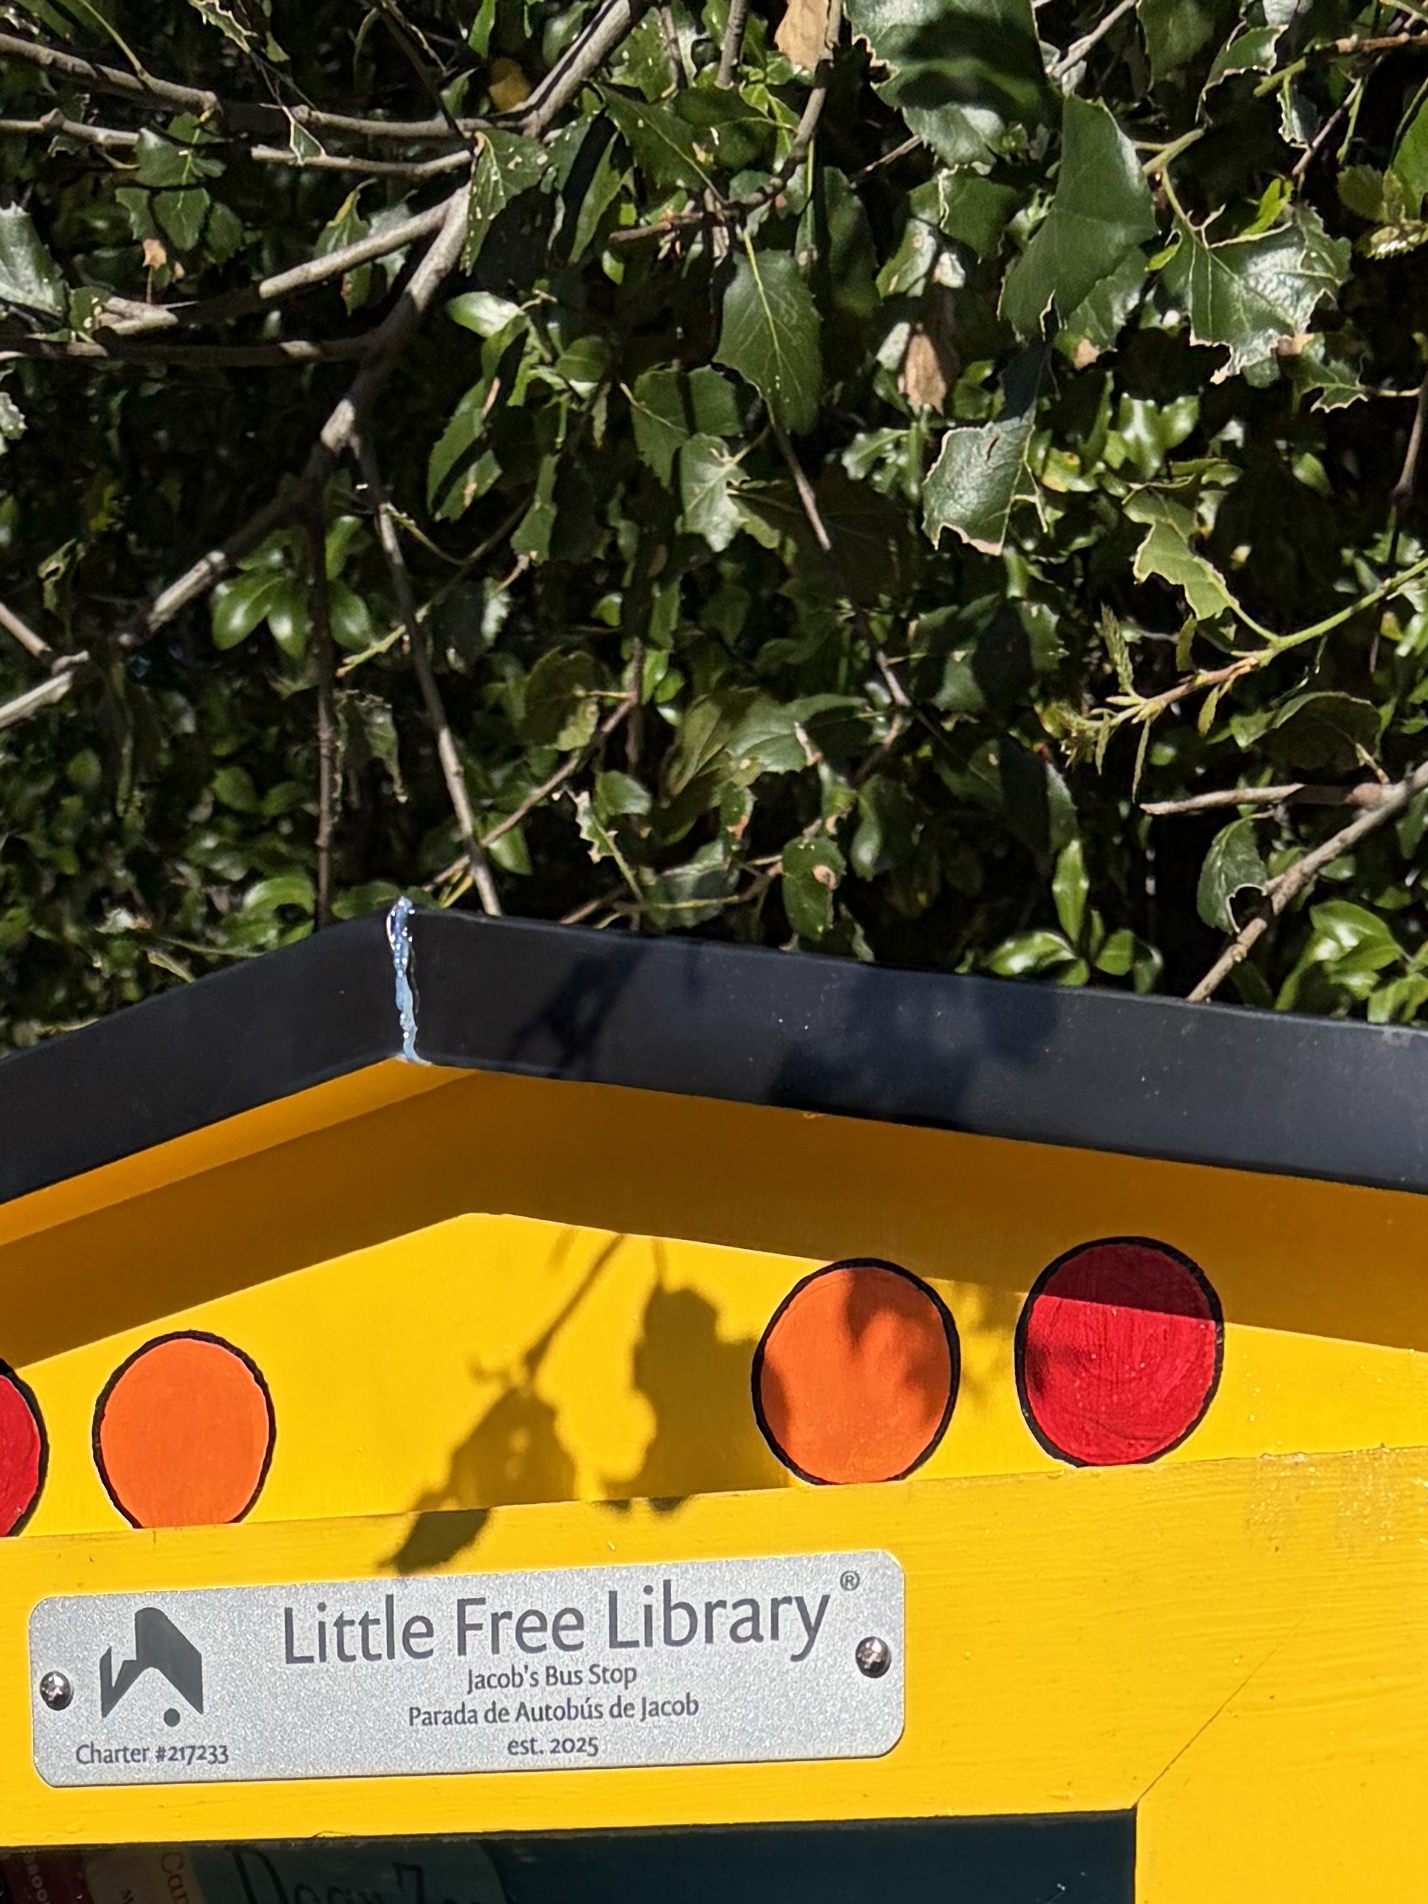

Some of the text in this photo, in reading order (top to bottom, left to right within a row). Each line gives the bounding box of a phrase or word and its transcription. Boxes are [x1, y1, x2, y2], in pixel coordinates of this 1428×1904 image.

[283, 1593, 436, 1665] Little
[455, 1597, 585, 1657] Free
[467, 1663, 638, 1695] Jacob's Bus Stop
[408, 1692, 700, 1727] Parada de Autobús de Jacob
[75, 1741, 230, 1766] Charter #217233
[507, 1736, 600, 1757] est. 2025
